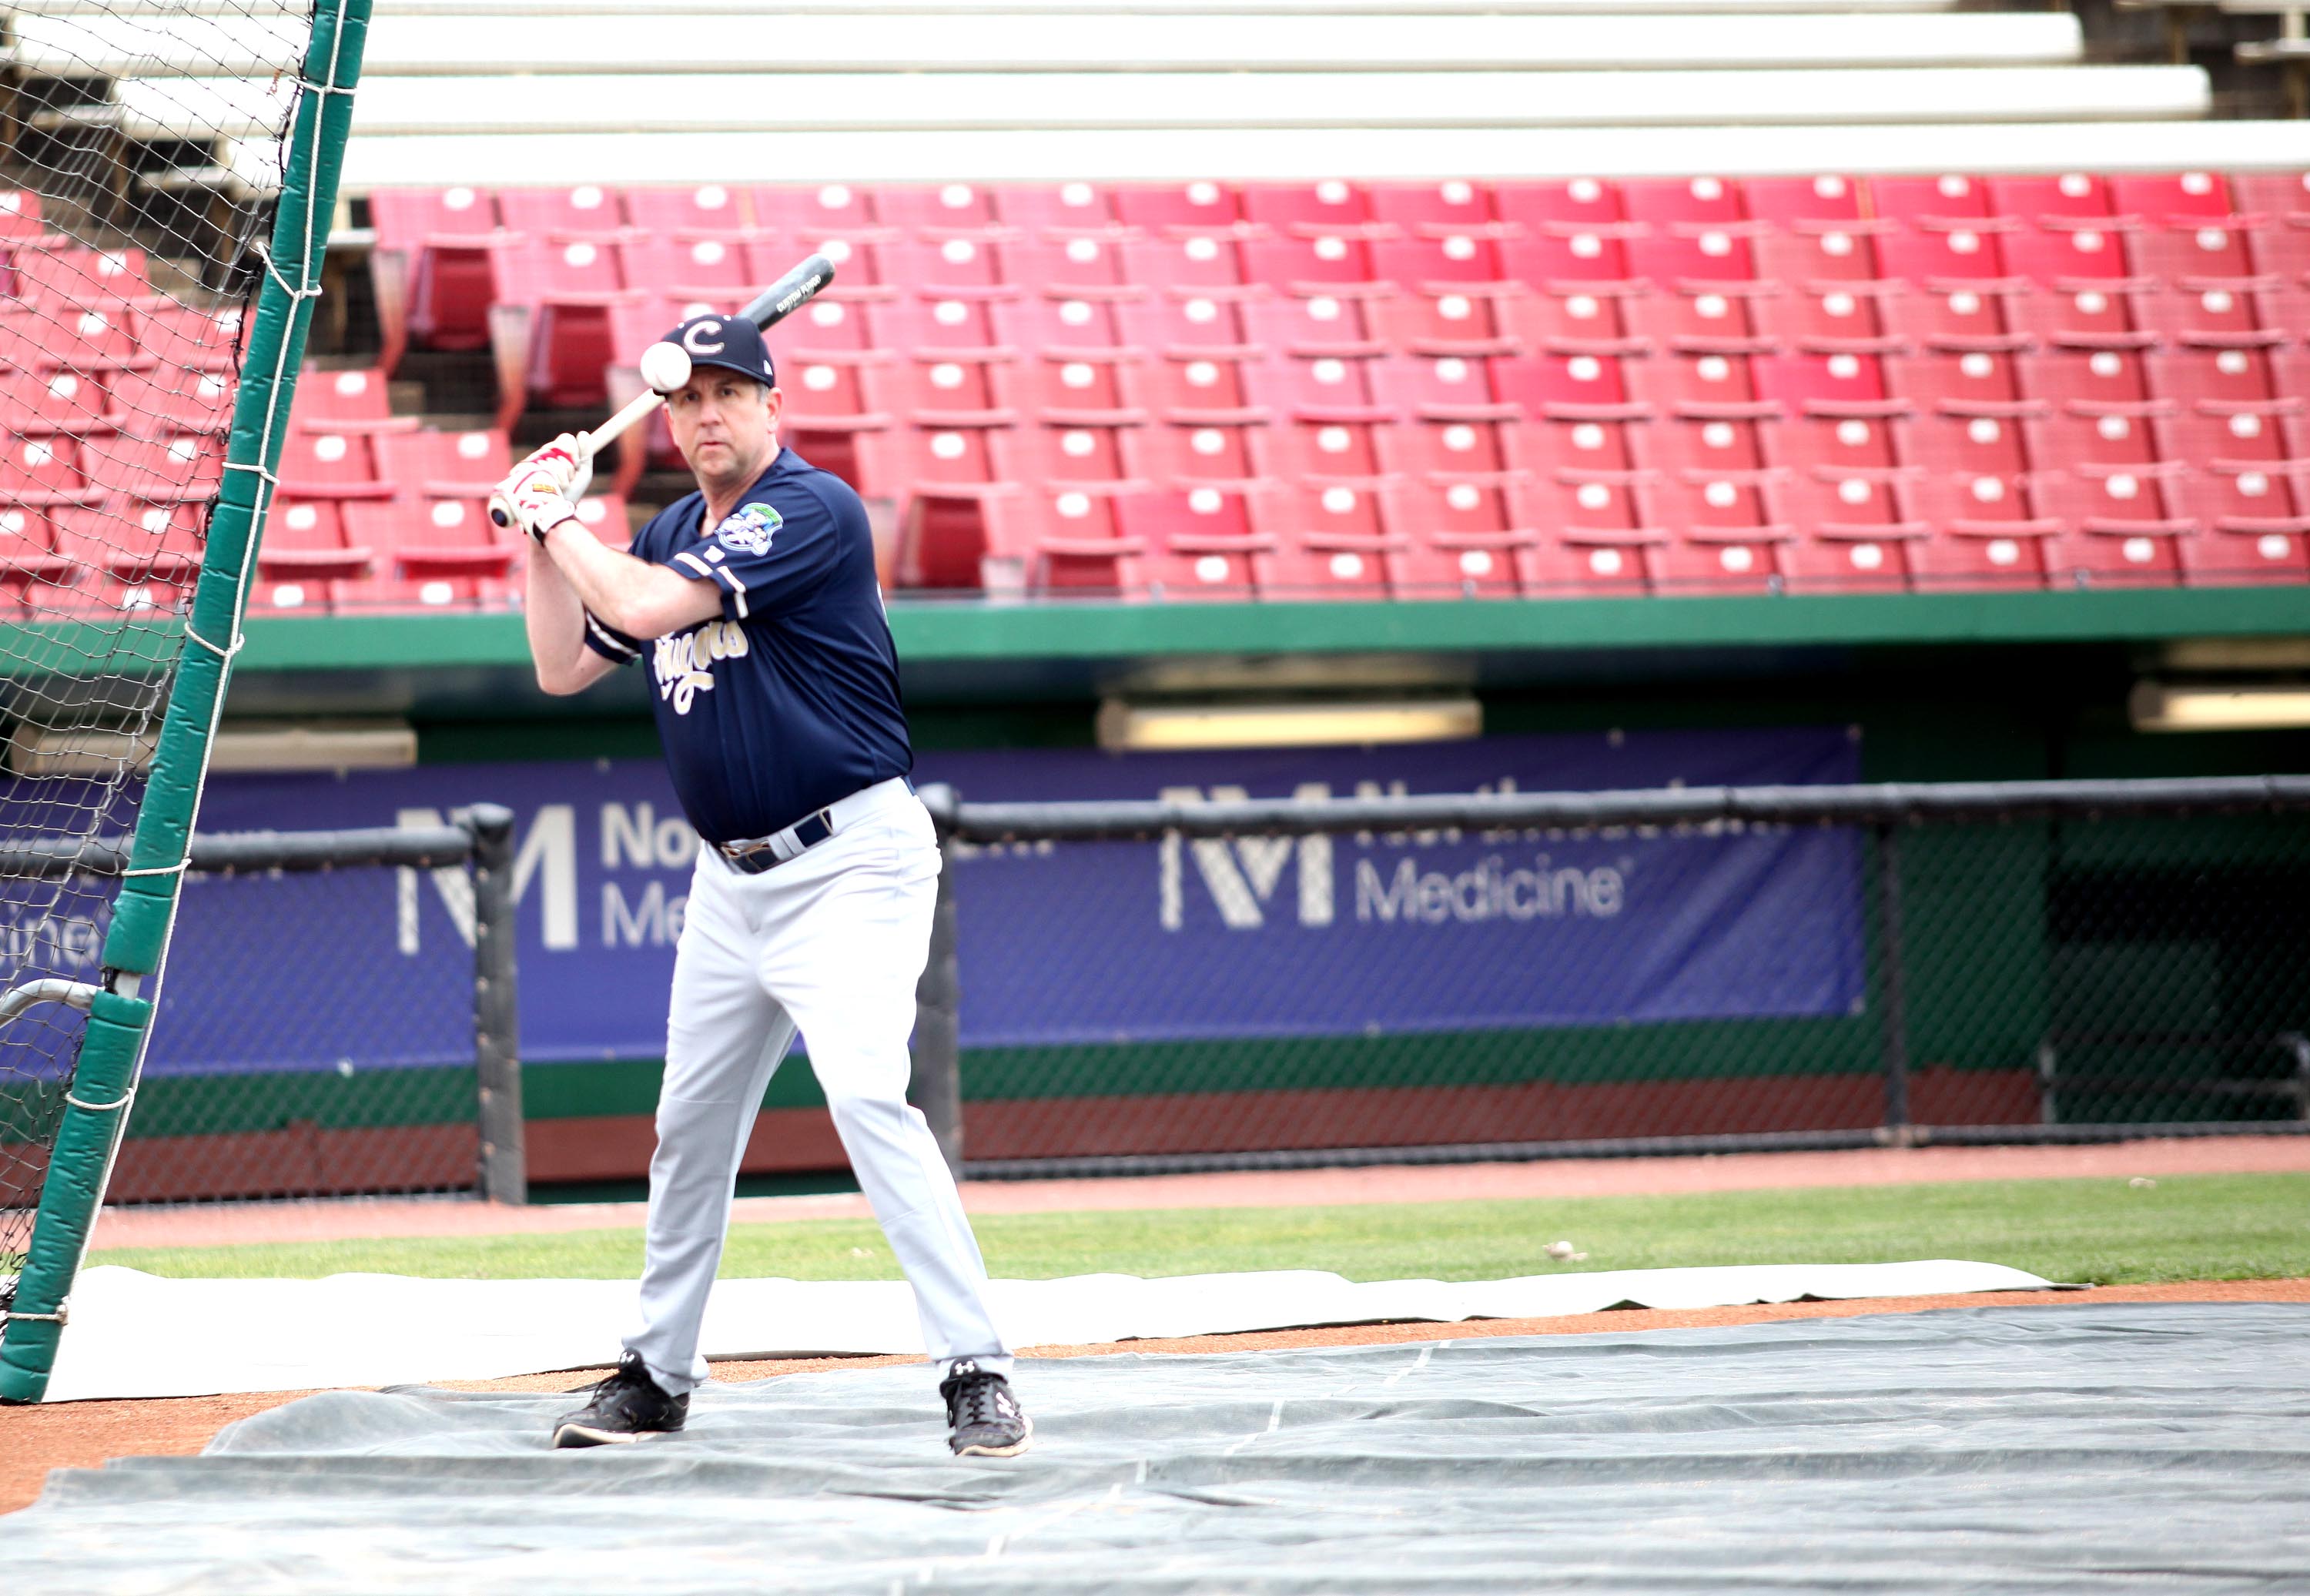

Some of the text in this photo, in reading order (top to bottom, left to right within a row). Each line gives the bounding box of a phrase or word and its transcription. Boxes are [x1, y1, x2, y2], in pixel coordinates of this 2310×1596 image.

[683, 320, 725, 356] C
[1355, 853, 1623, 924] Medicine
[0, 902, 100, 967] ine
